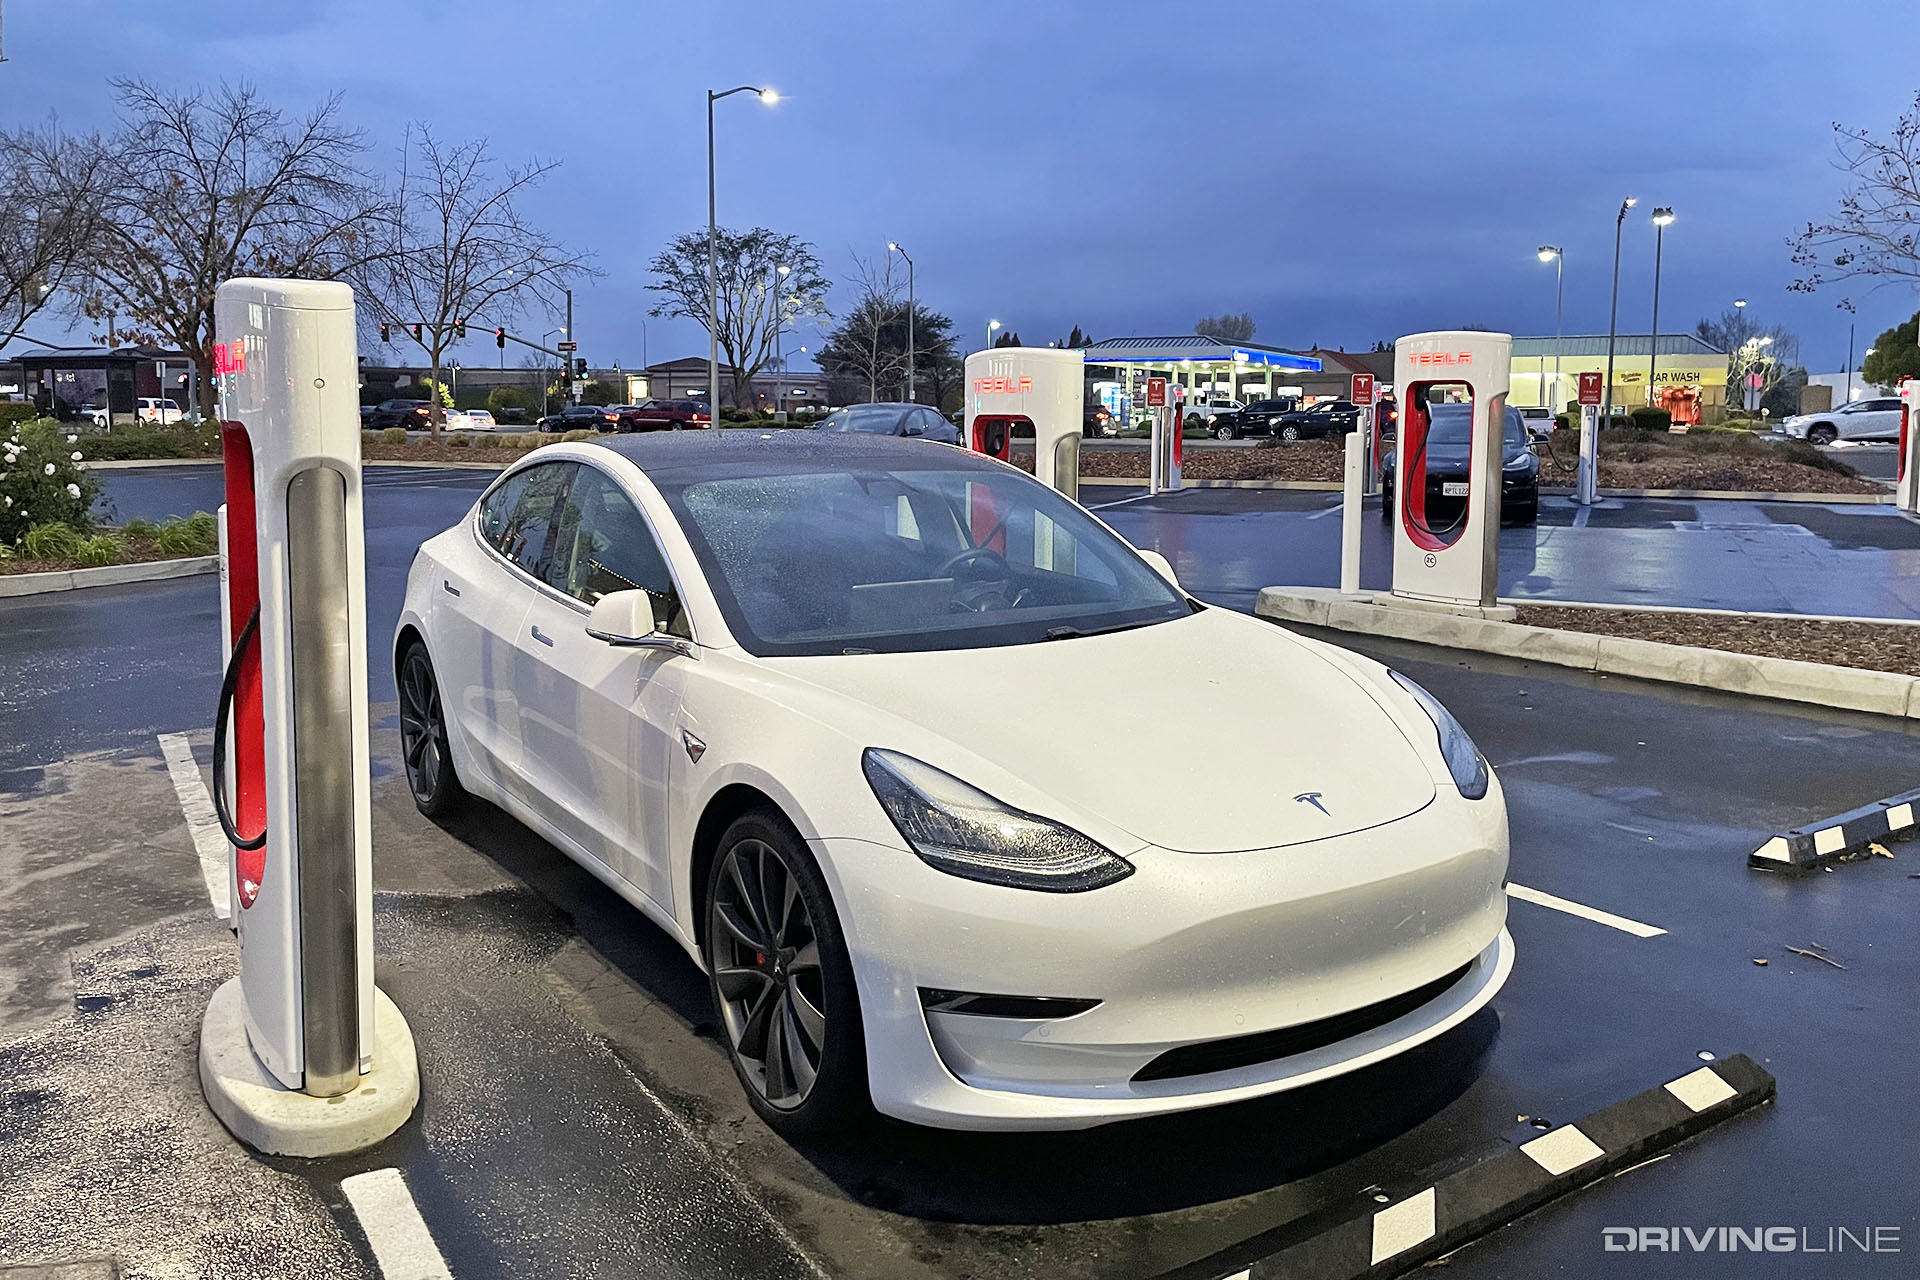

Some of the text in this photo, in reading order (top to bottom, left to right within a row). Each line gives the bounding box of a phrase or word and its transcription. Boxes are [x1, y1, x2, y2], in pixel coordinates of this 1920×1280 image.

[1408, 351, 1473, 366] TESLA
[1653, 372, 1668, 382] AR
[1670, 372, 1700, 382] WASH
[972, 376, 1033, 394] TESLA
